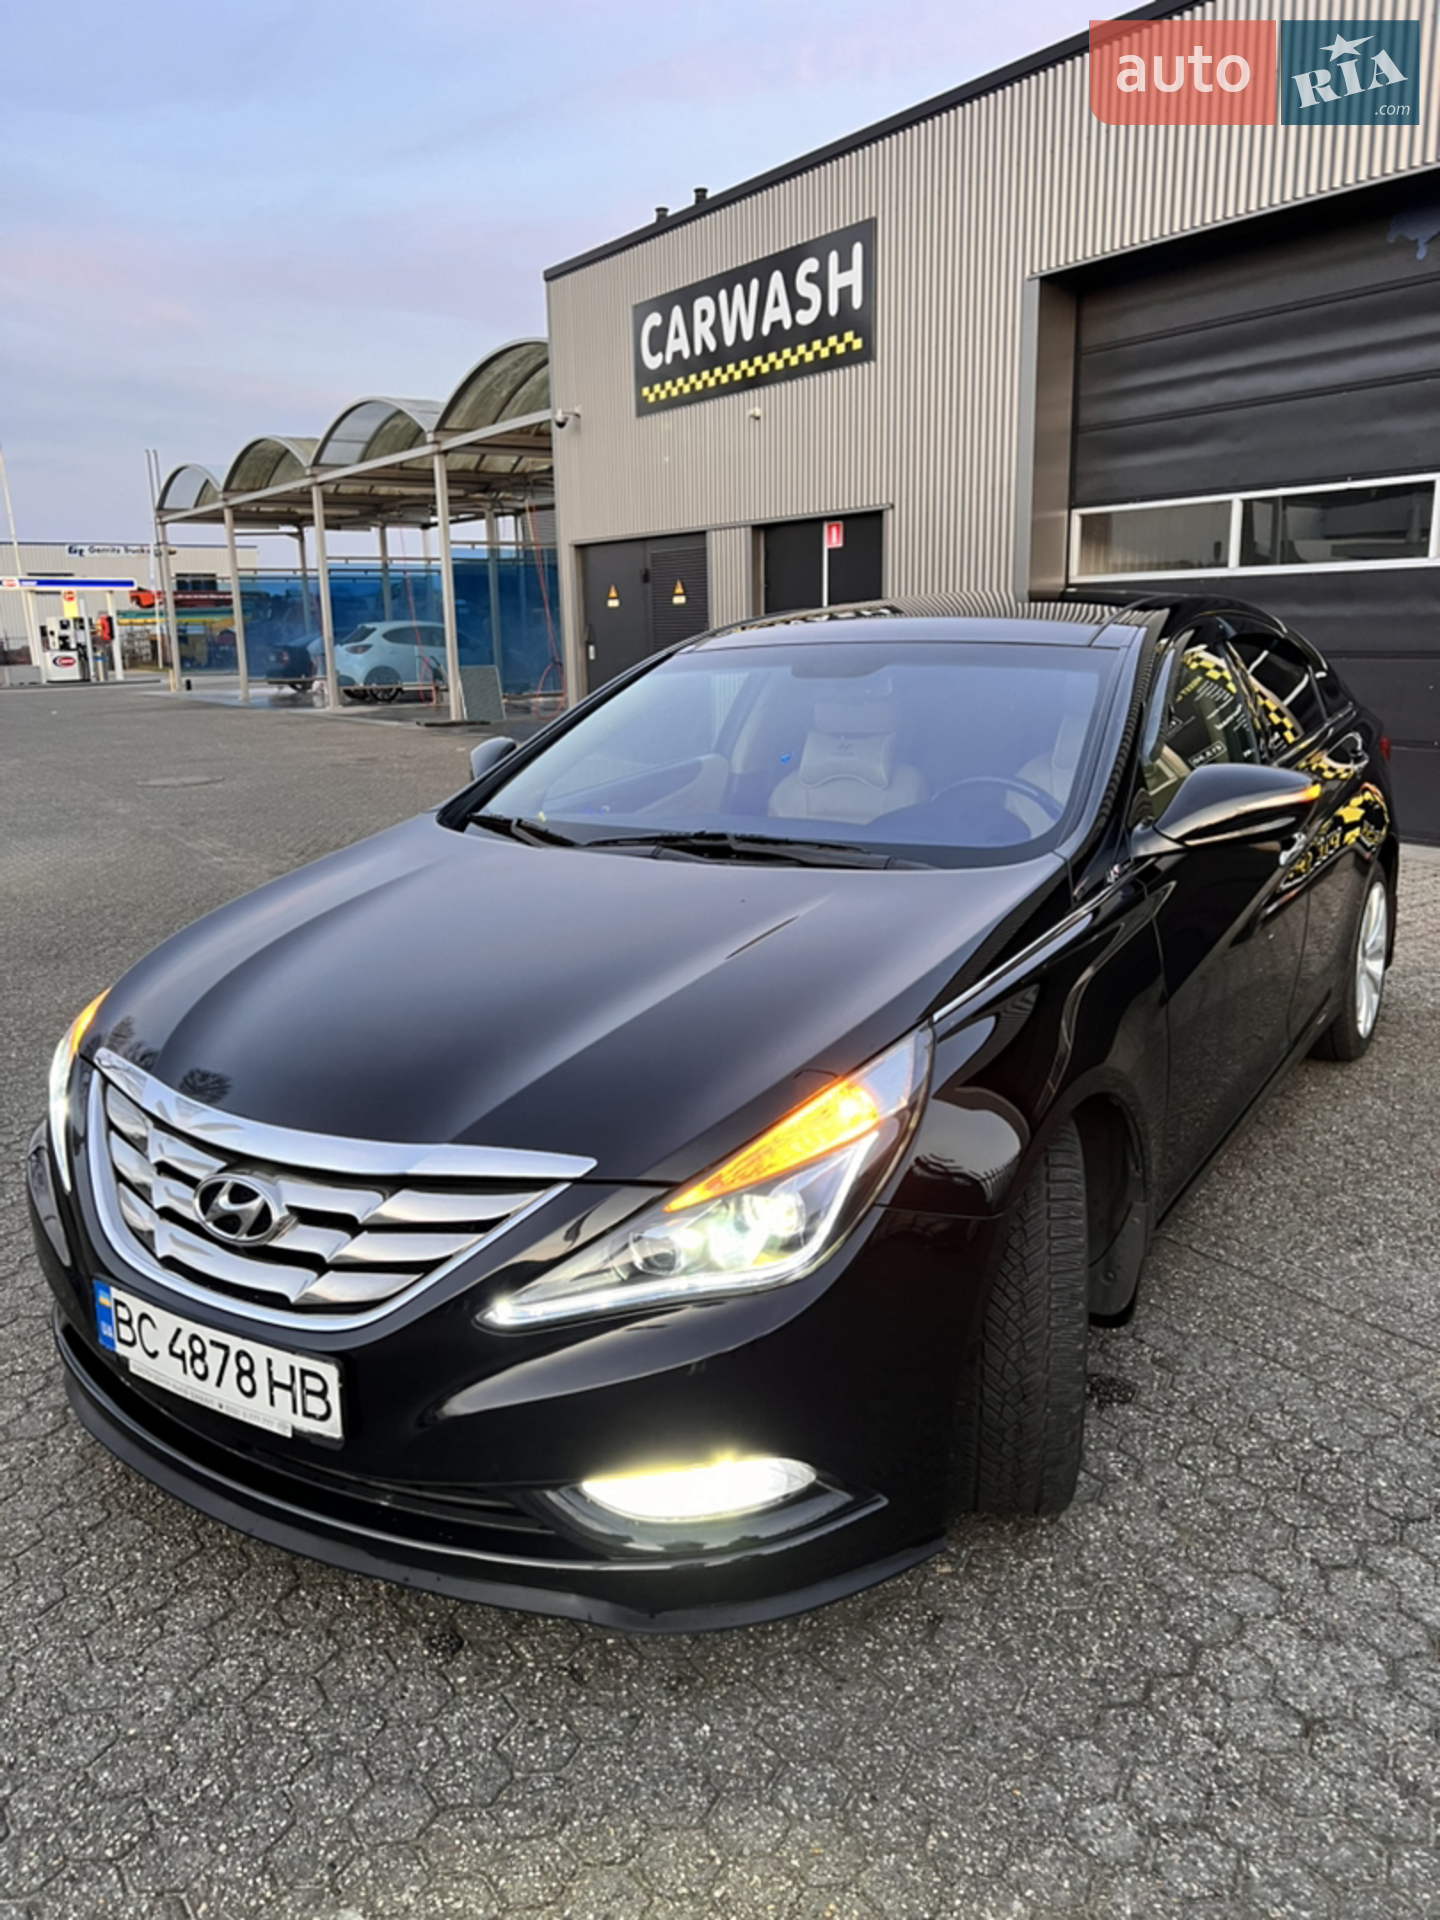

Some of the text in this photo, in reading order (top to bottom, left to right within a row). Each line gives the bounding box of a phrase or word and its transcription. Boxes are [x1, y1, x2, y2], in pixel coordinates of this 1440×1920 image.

[640, 241, 863, 369] CARWASH
[113, 1298, 159, 1359] BC
[168, 1327, 257, 1398] 4878
[266, 1357, 332, 1421] HB
